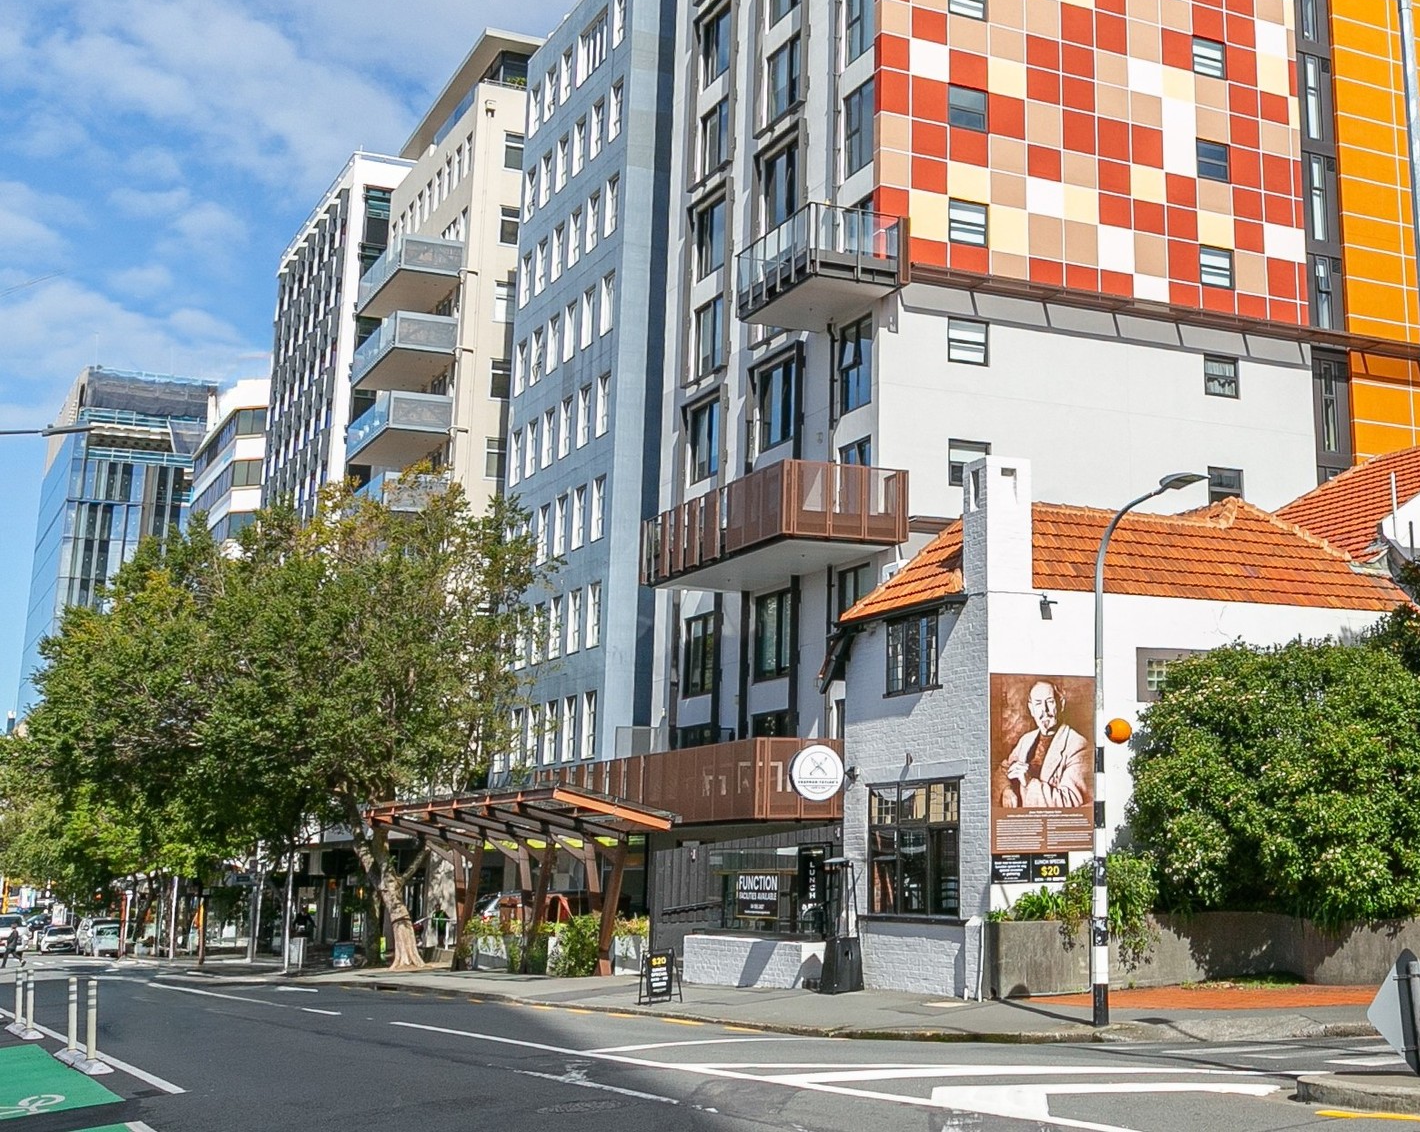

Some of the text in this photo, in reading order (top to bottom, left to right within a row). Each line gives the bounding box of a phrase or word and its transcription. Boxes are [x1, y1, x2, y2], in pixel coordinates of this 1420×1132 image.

[1040, 865, 1060, 876] $20
[738, 875, 778, 891] FUNCTION
[808, 861, 816, 900] LUNCH
[739, 891, 777, 901] FACILITIES AVAILABLE
[651, 956, 667, 966] $20
